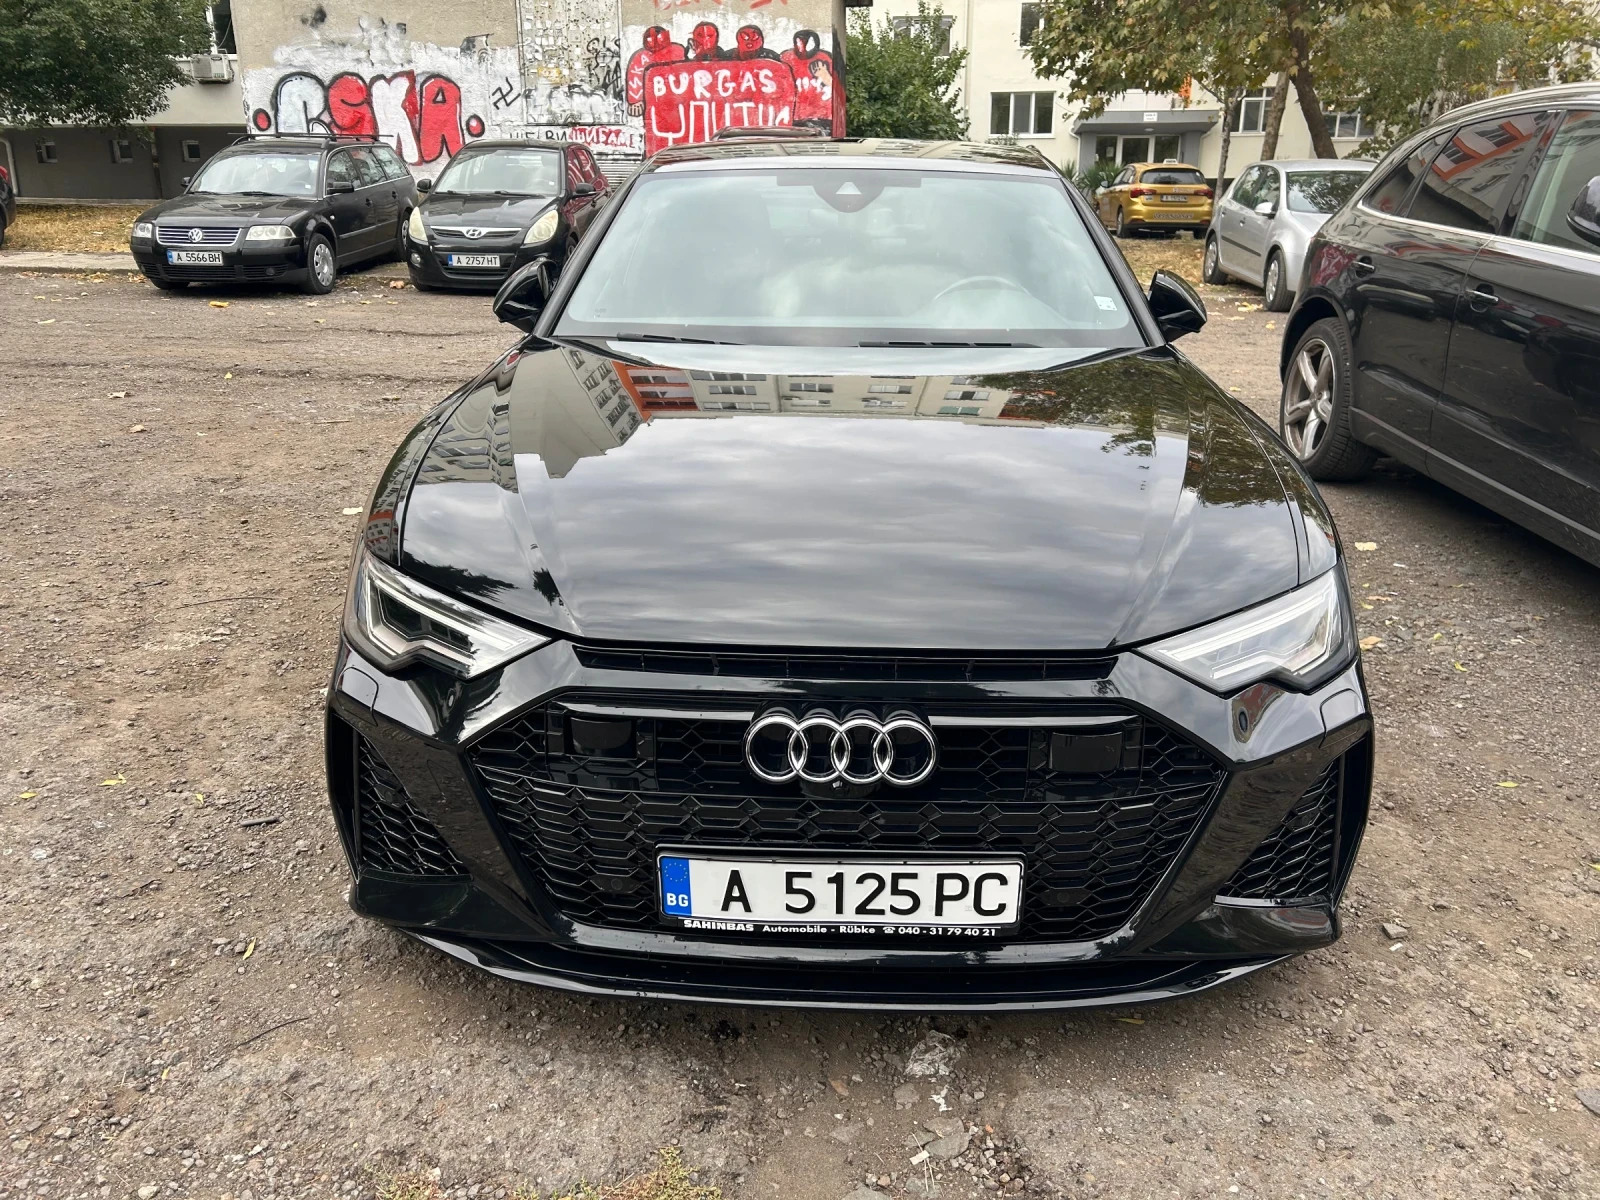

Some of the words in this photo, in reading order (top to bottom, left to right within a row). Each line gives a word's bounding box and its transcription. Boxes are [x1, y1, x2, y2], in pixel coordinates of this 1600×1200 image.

[653, 69, 777, 99] BURGAS
[177, 253, 182, 262] A
[457, 256, 462, 265] A
[720, 869, 752, 913] A
[666, 893, 689, 907] BG
[684, 919, 754, 931] SAHINBAS
[762, 925, 827, 933] Automobile
[839, 925, 876, 934] Rübke
[898, 927, 920, 935] 040
[947, 928, 962, 936] 79
[964, 928, 980, 936] 40
